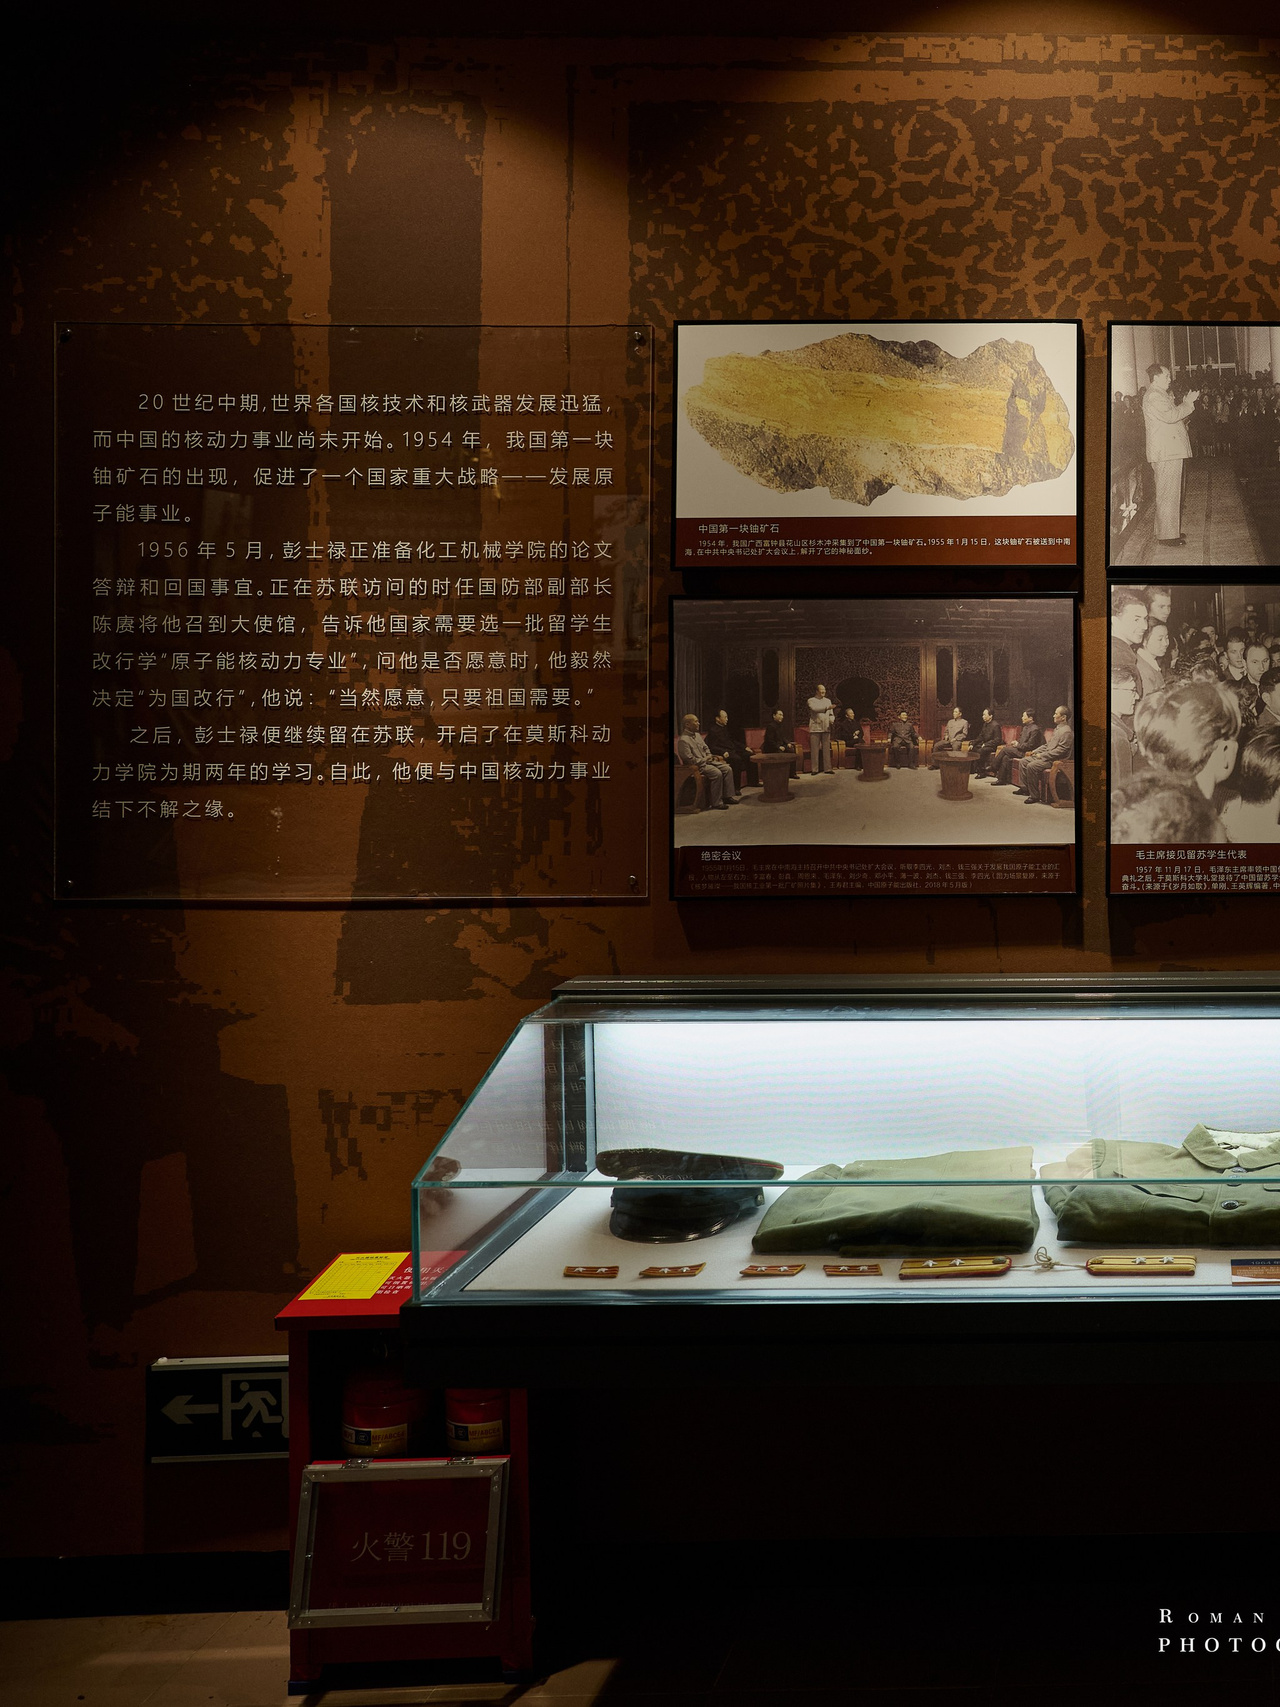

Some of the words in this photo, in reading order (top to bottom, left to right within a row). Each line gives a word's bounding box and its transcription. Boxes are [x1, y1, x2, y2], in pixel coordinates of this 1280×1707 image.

[92, 504, 193, 524] 子能事业。
[699, 524, 780, 534] 中国第一块铀矿石
[92, 799, 236, 820] 结下不解之缘。
[701, 851, 742, 861] 绝密会议
[1136, 850, 1247, 860] 毛主席接见留苏学生代表
